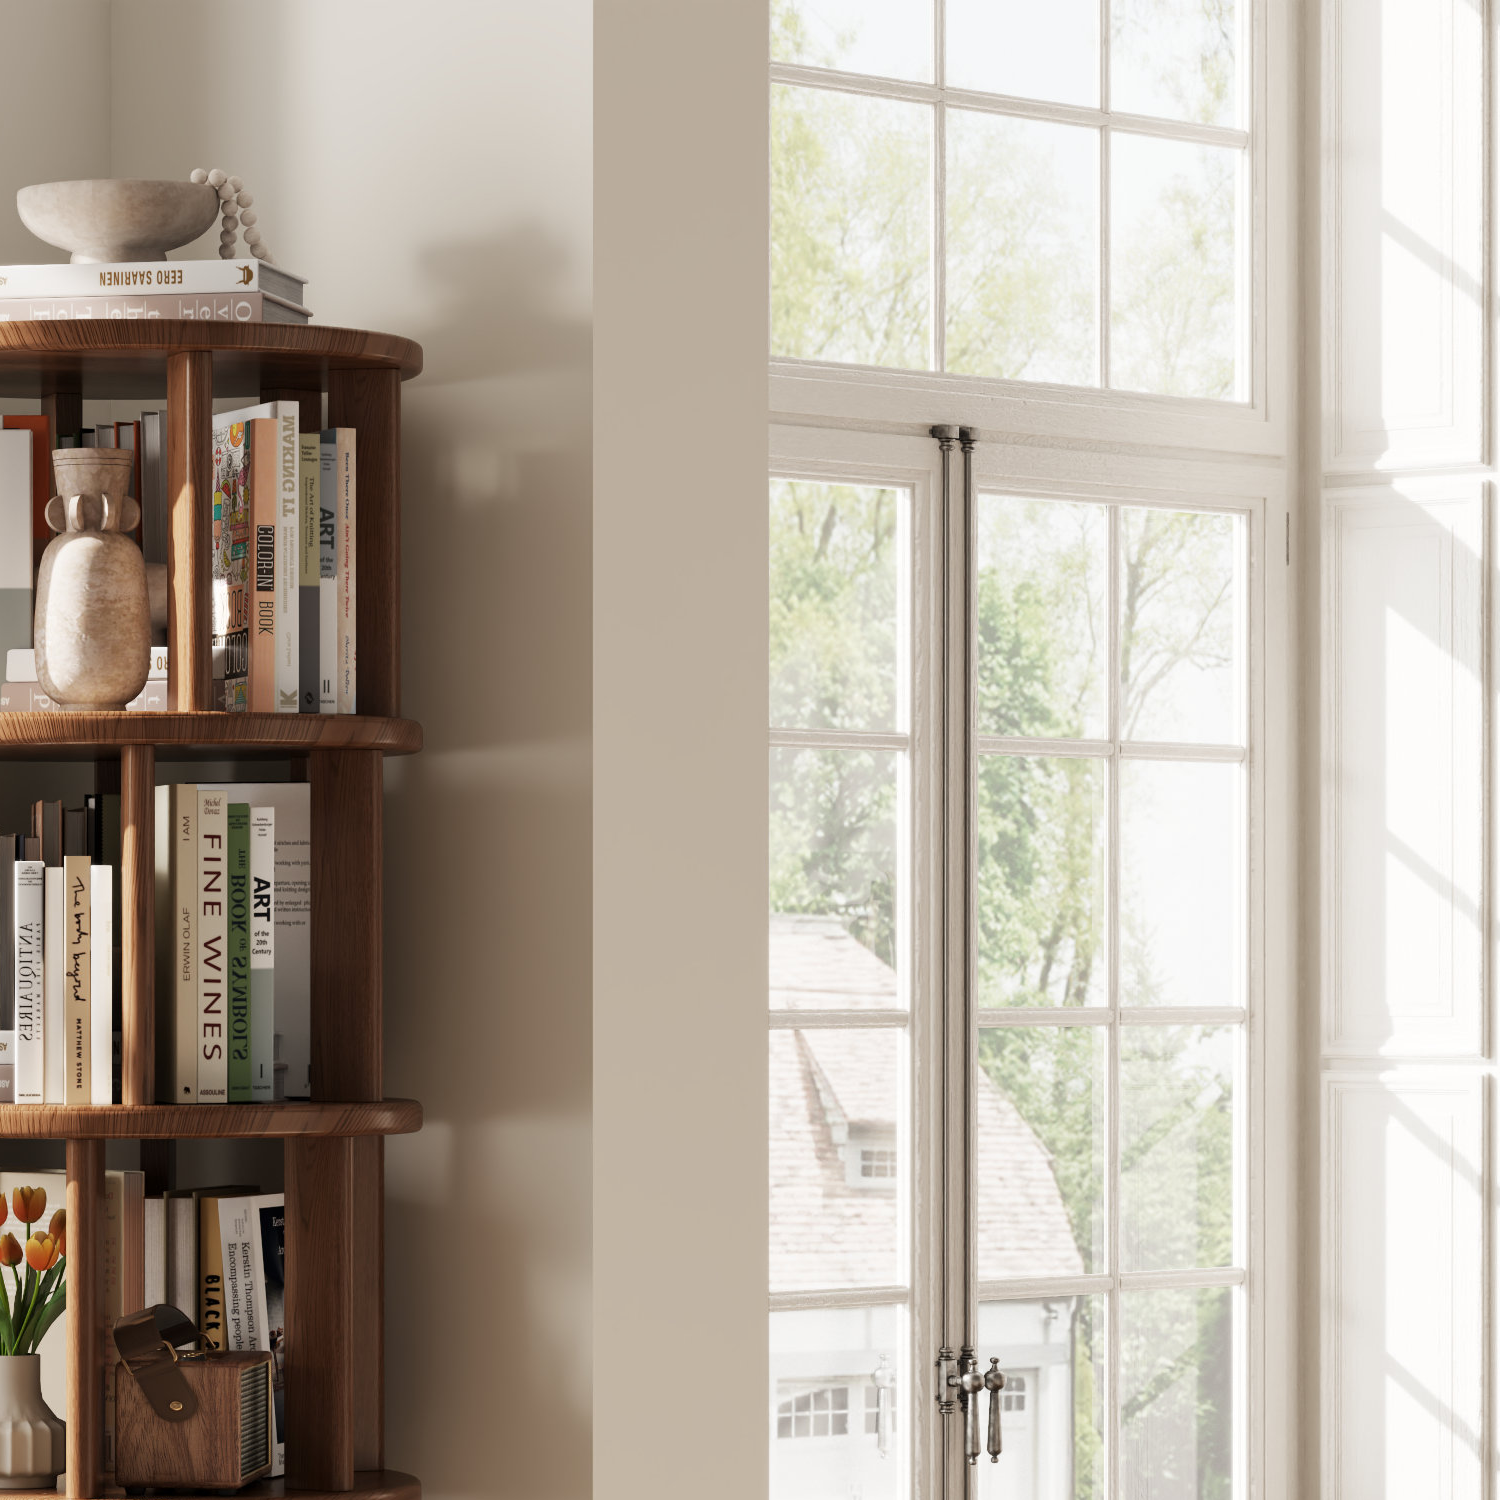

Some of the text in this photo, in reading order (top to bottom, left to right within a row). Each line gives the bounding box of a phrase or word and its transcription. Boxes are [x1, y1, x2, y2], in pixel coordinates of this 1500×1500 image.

[100, 270, 183, 286] EERO SAARINEN
[320, 507, 335, 550] ART
[258, 601, 274, 635] BOOK
[182, 816, 190, 836] AM
[253, 876, 271, 922] ART
[66, 876, 89, 1003] The body beyond
[203, 834, 222, 1060] FINE WINES
[204, 1274, 221, 1331] BLACK
[228, 1243, 243, 1350] Encompassing people
[242, 1242, 255, 1335] Kerstin Thompson
